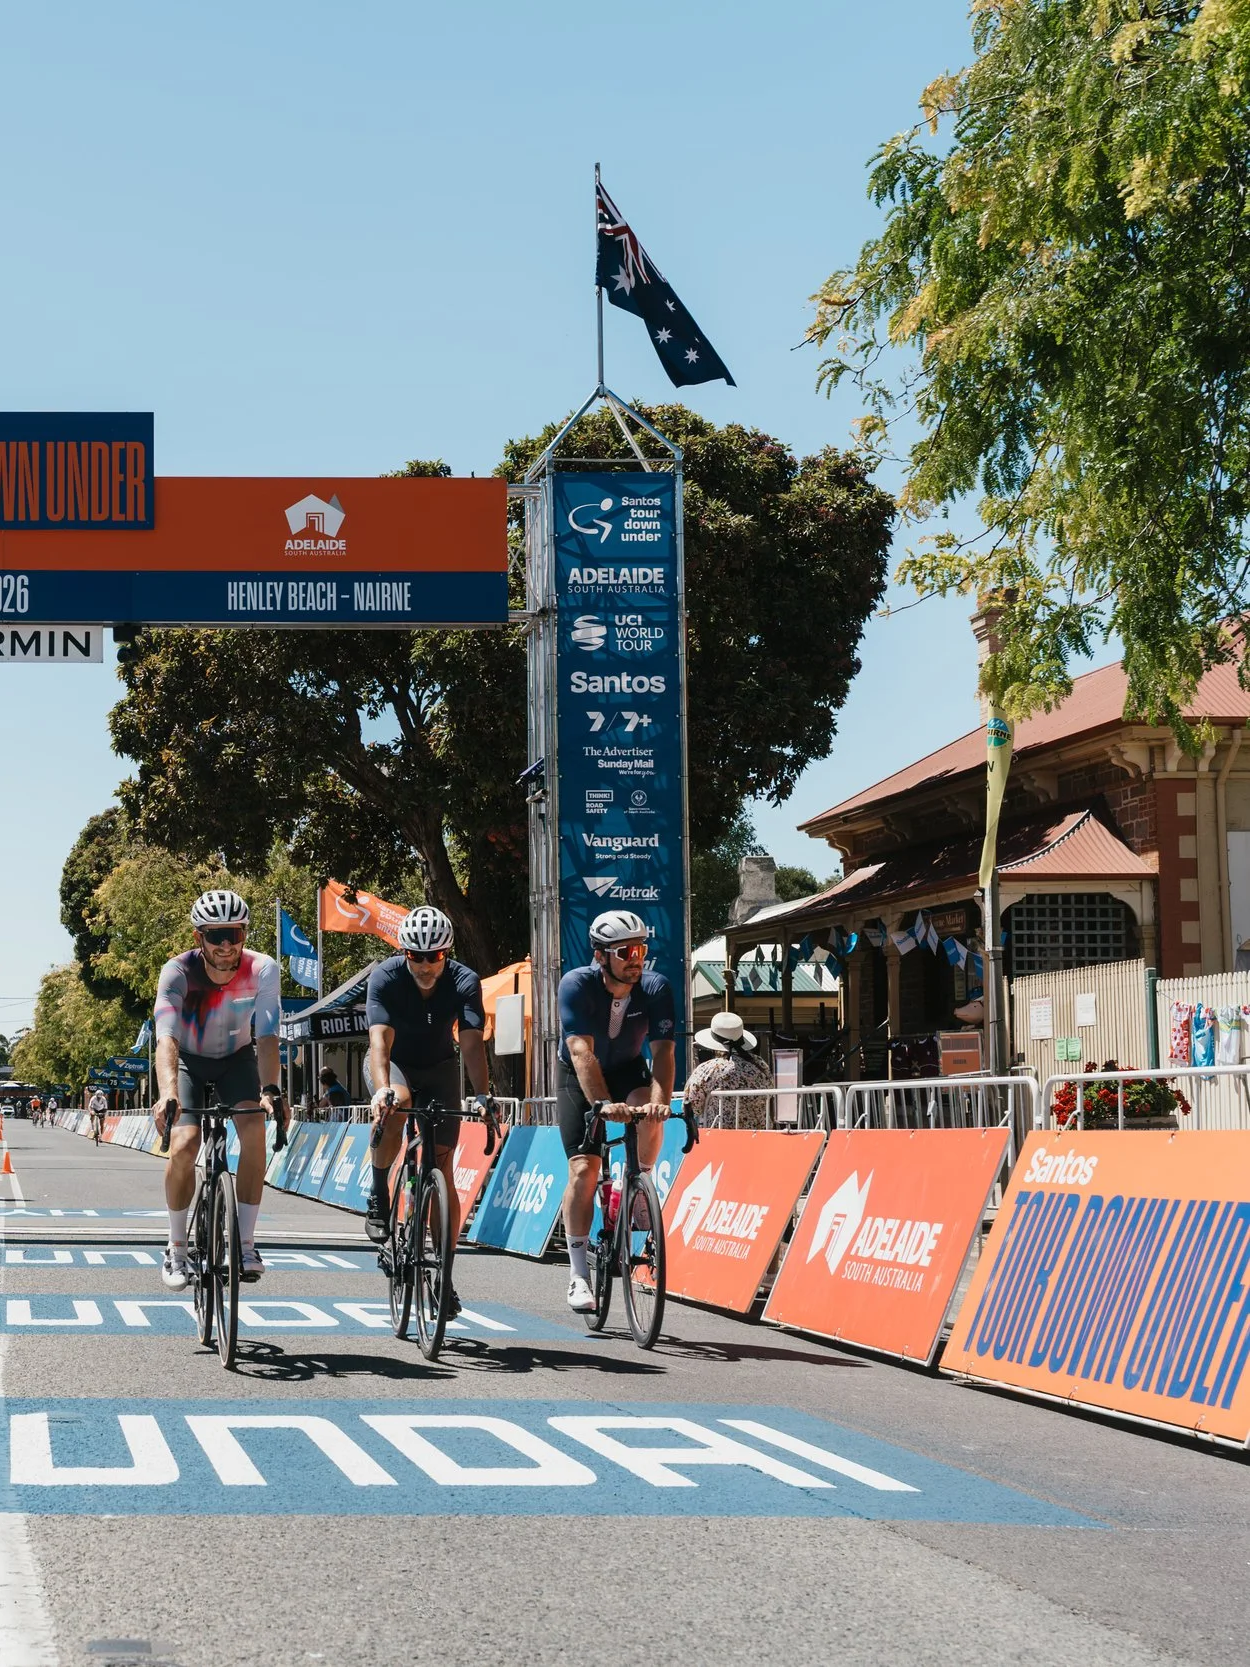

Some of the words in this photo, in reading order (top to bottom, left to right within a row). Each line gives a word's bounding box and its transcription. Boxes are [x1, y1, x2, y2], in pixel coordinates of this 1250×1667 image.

[48, 441, 146, 522] UNDER
[622, 497, 661, 506] Santos
[630, 508, 660, 518] tour
[624, 519, 660, 529] down
[284, 539, 346, 550] ADELAIDE
[621, 532, 661, 541] under
[568, 568, 664, 584] ADELAIDE
[227, 581, 284, 611] HENLEY
[288, 581, 337, 611] BEACH
[354, 581, 411, 611] NAIRNE
[615, 615, 642, 626] UCI
[615, 627, 664, 638] WORLD
[616, 640, 652, 651] TOUR
[570, 672, 666, 693] Santos
[583, 747, 602, 756] The
[603, 747, 654, 756] Advertiser
[582, 833, 659, 851] Vanguard
[609, 885, 661, 900] Ziptrak
[321, 1017, 351, 1034] RIDE
[1024, 1147, 1098, 1185] Santos
[496, 1160, 554, 1214] Santos
[701, 1200, 769, 1240] ADELAIDE
[692, 1236, 712, 1253] SOUTH
[711, 1239, 751, 1260] AUSTRALIA
[851, 1216, 943, 1267] ADELAIDE
[841, 1261, 872, 1284] SOUTH
[872, 1264, 925, 1293] AUSTRALIA
[963, 1191, 1080, 1363] TOUR
[1028, 1195, 1182, 1384] DOWN
